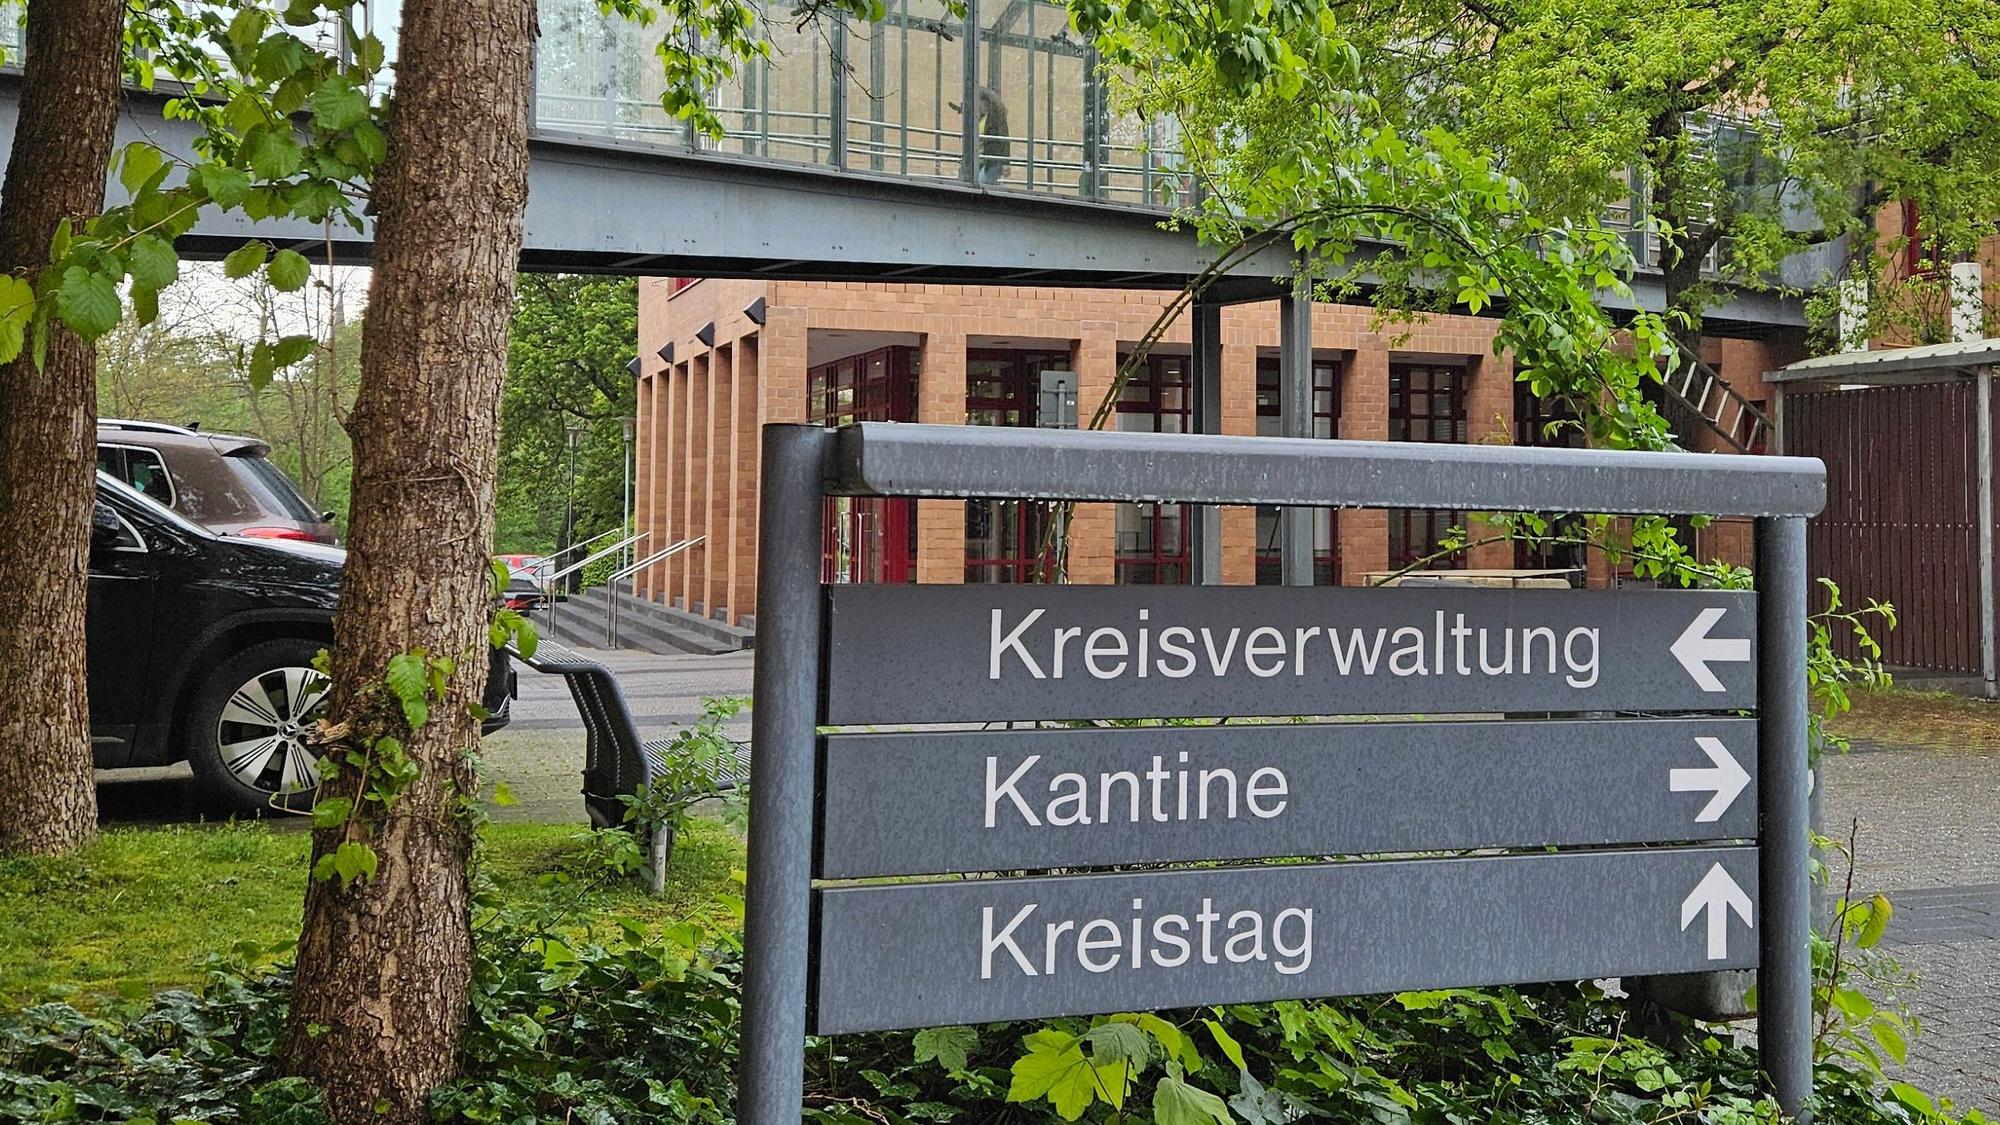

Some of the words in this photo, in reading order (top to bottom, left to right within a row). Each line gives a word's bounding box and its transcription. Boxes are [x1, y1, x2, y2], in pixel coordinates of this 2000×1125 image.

[989, 608, 1600, 689] Kreisverwaltung
[984, 751, 1288, 828] Kantine
[980, 897, 1314, 979] Kreistag
